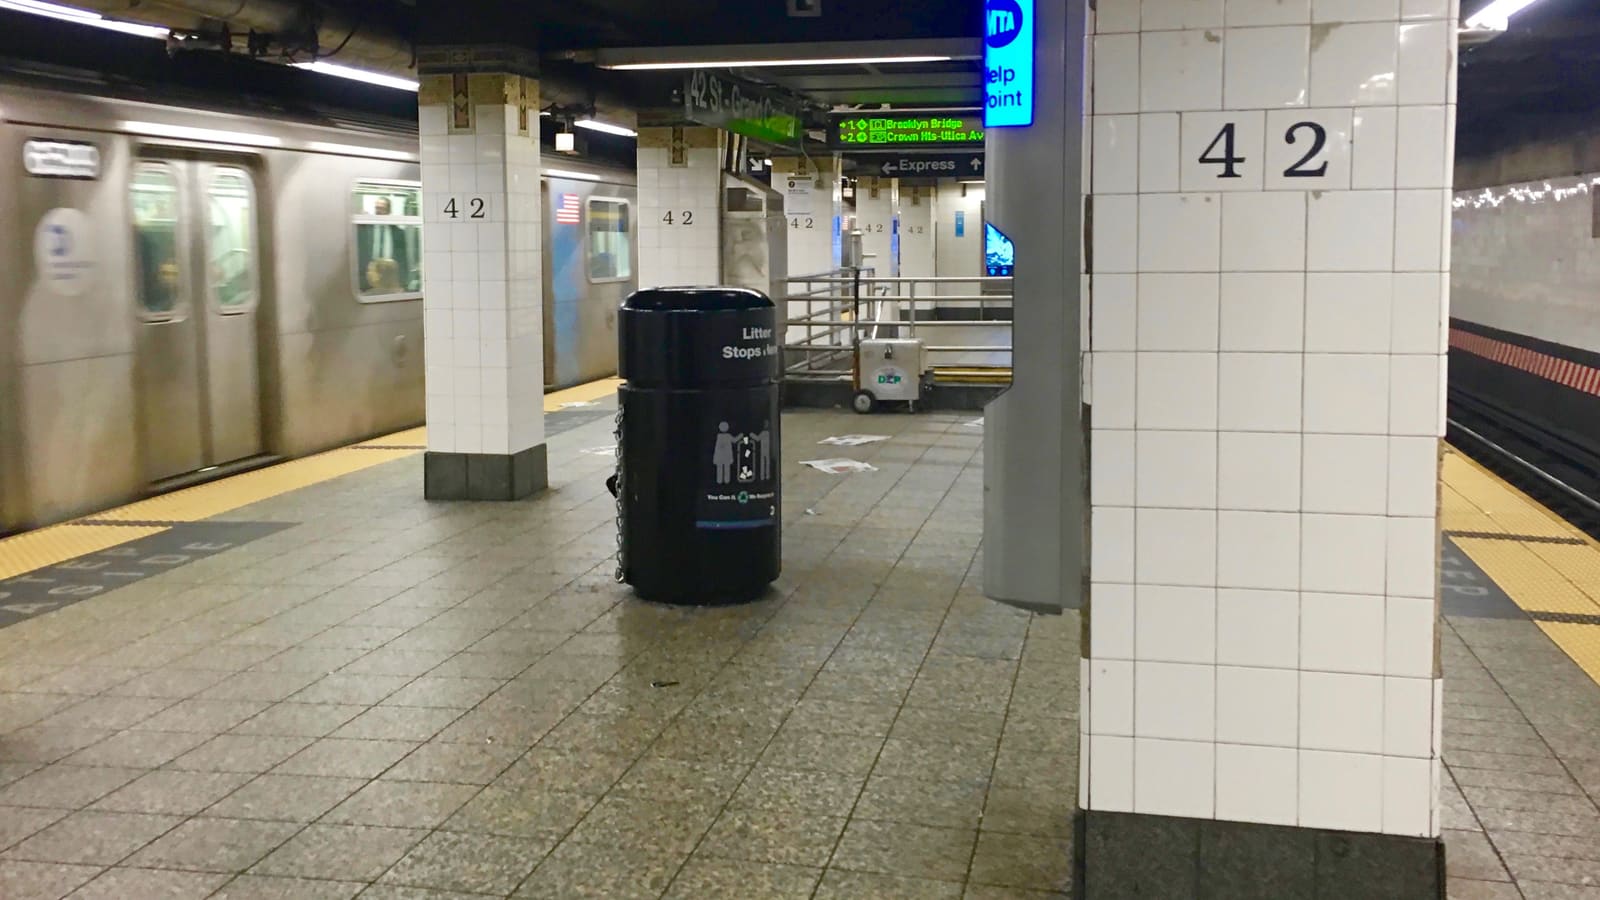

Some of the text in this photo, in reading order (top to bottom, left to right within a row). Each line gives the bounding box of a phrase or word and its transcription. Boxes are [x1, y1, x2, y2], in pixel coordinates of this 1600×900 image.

[691, 69, 707, 109] 42
[709, 75, 724, 113] St
[887, 119, 928, 130] Brooklyn
[931, 118, 963, 130] Bridge
[887, 132, 919, 142] Crown
[900, 159, 955, 173] Express
[742, 327, 772, 340] Litter
[722, 345, 761, 360] Stops
